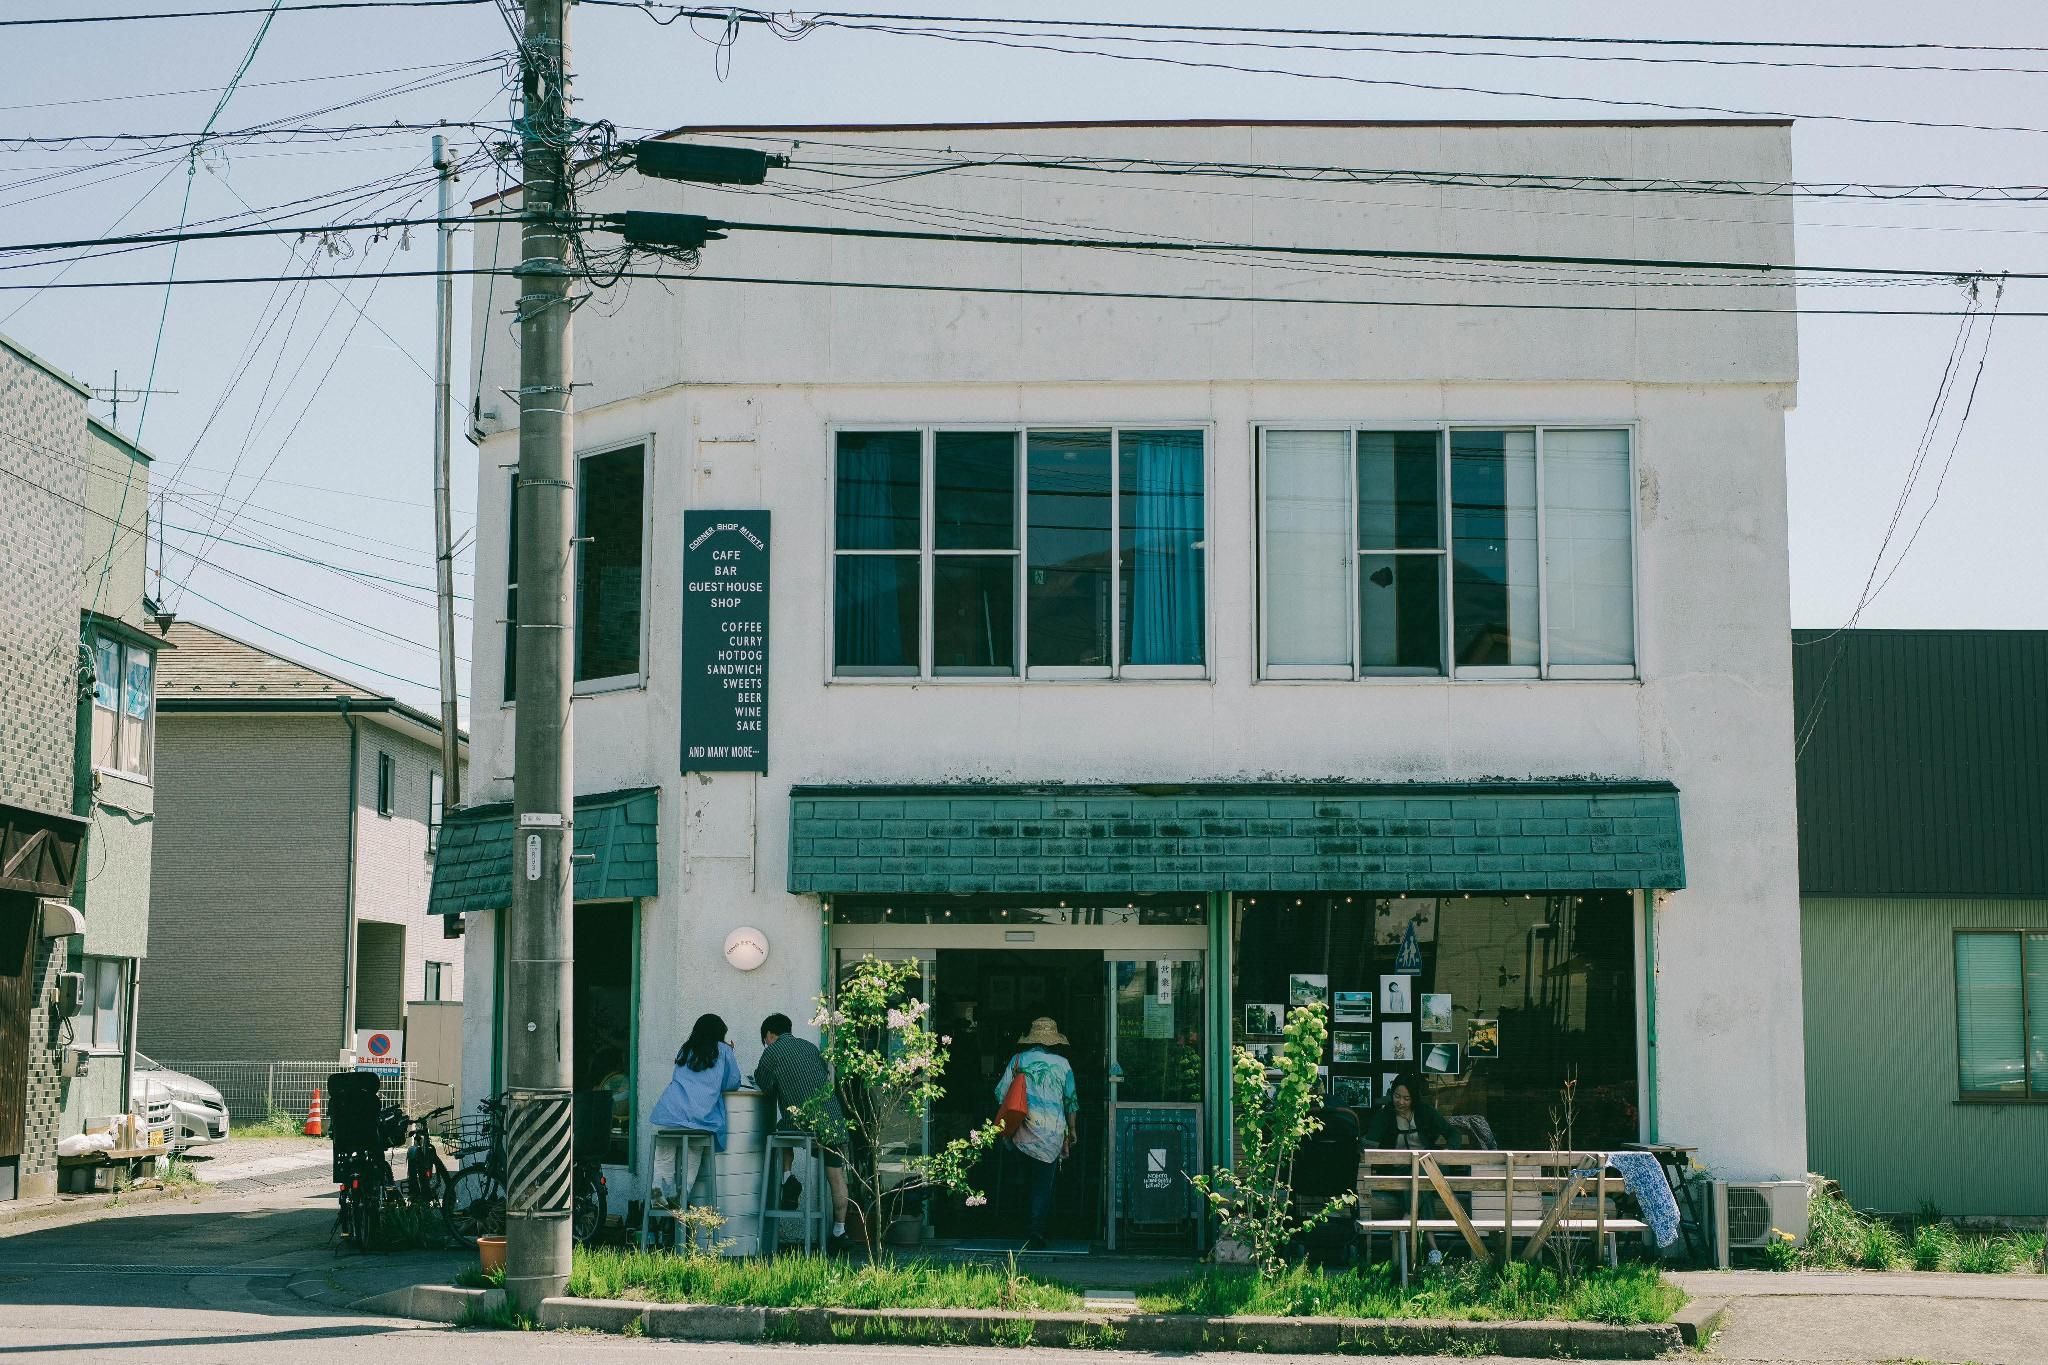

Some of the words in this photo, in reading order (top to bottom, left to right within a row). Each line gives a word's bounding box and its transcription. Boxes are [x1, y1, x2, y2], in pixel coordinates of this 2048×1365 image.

[689, 526, 716, 551] CORNER
[716, 523, 739, 531] SHOP
[739, 526, 765, 551] MIYOTA
[712, 550, 741, 560] CAFE
[714, 566, 737, 576] BAR
[688, 582, 724, 592] GUEST
[726, 582, 763, 592] HOUSE
[711, 598, 741, 608] SHOP
[721, 621, 762, 632] COFFEE
[729, 636, 762, 647] CURRY
[718, 650, 762, 661] HOTDOG
[707, 664, 762, 675] SANDWICH
[723, 678, 762, 689] SWEETS
[738, 692, 762, 703] BEER
[735, 706, 761, 717] WINE
[736, 720, 762, 731] SAKE
[688, 746, 705, 758] AND
[707, 746, 729, 758] MANY
[1160, 965, 1170, 1001] 営業中
